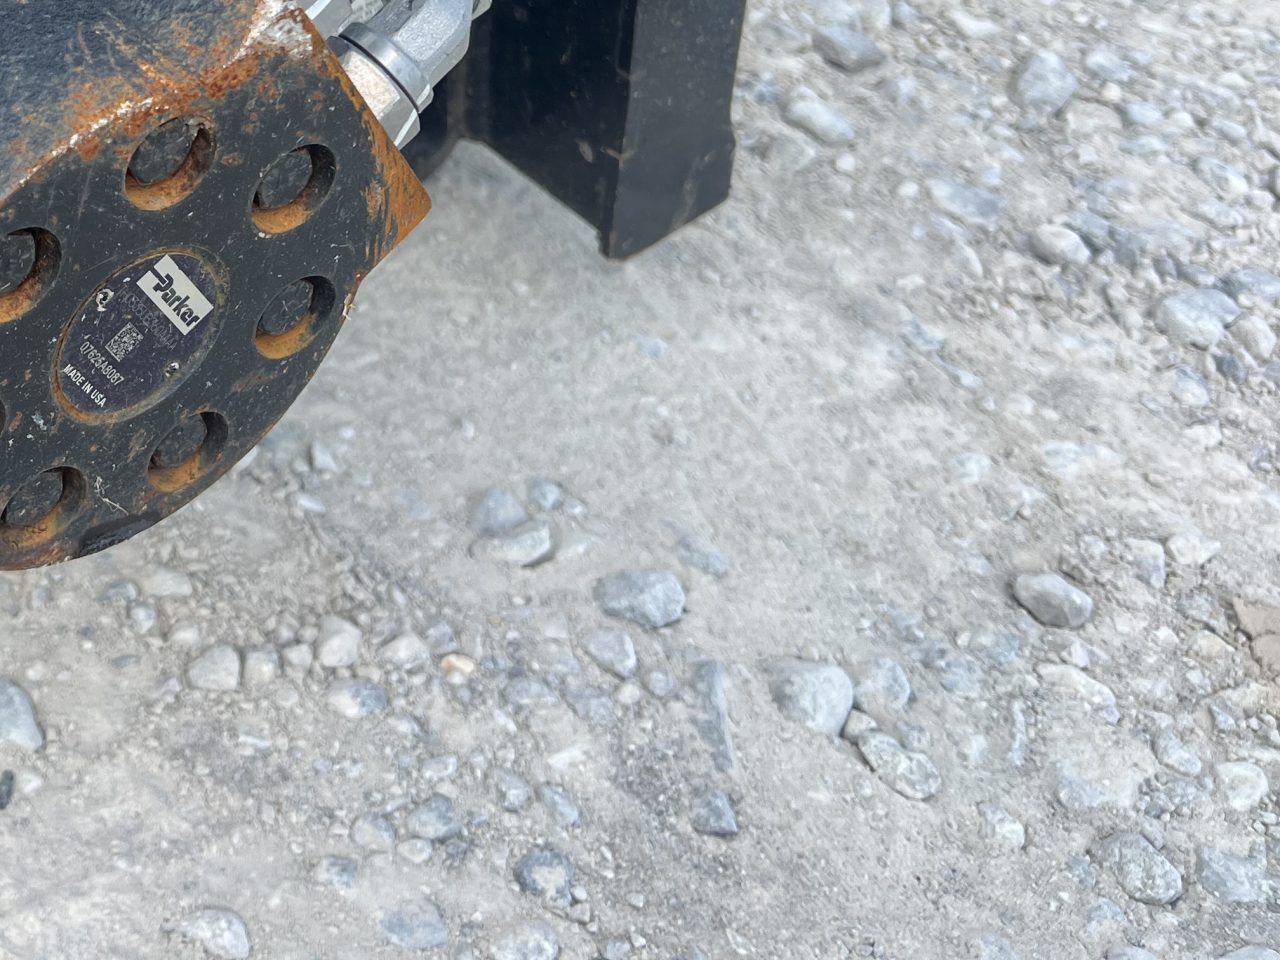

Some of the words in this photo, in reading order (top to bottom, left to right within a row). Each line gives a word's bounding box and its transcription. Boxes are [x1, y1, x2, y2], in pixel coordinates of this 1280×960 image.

[152, 273, 200, 327] Parker
[63, 363, 86, 386] MADE
[81, 380, 94, 394] IN
[90, 389, 107, 408] USA
